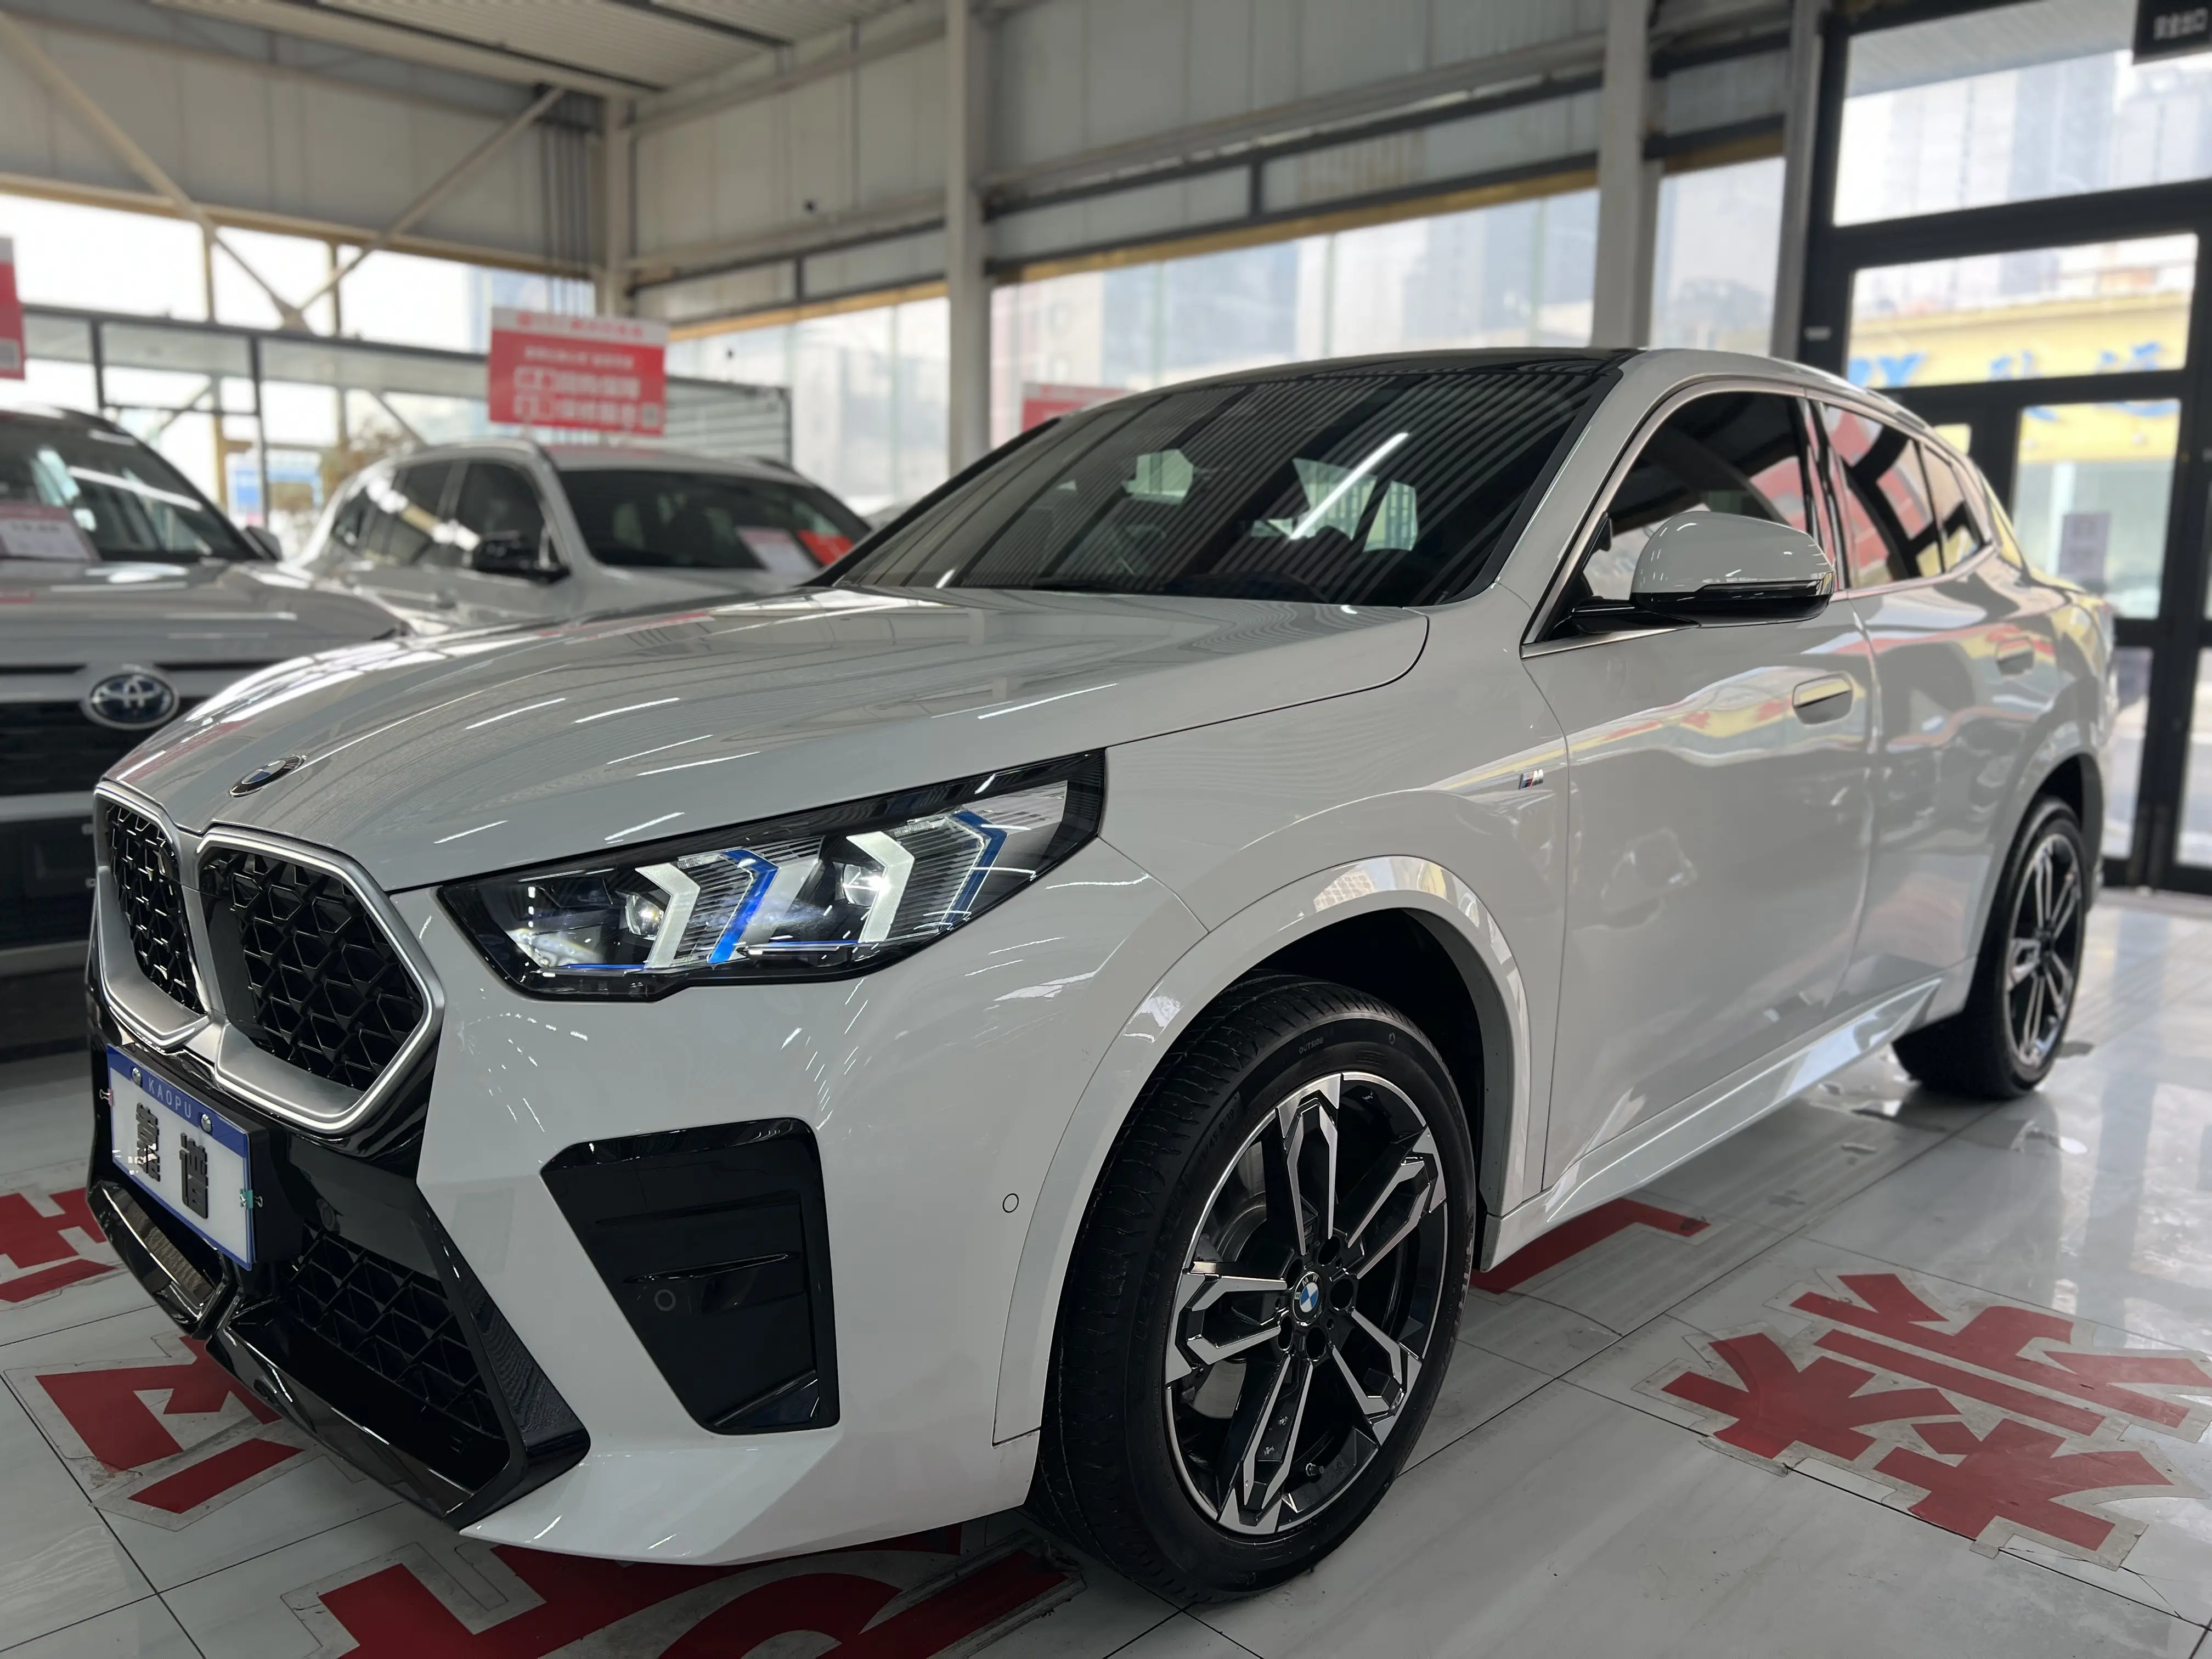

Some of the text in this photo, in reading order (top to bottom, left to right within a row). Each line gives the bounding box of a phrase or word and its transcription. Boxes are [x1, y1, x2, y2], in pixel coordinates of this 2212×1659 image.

[1299, 1037, 1324, 1054] OUTSIDE
[149, 1077, 191, 1119] KAOPU
[1218, 1121, 1225, 1133] R
[1226, 1109, 1234, 1121] 19
[1294, 1273, 1319, 1300] BMW
